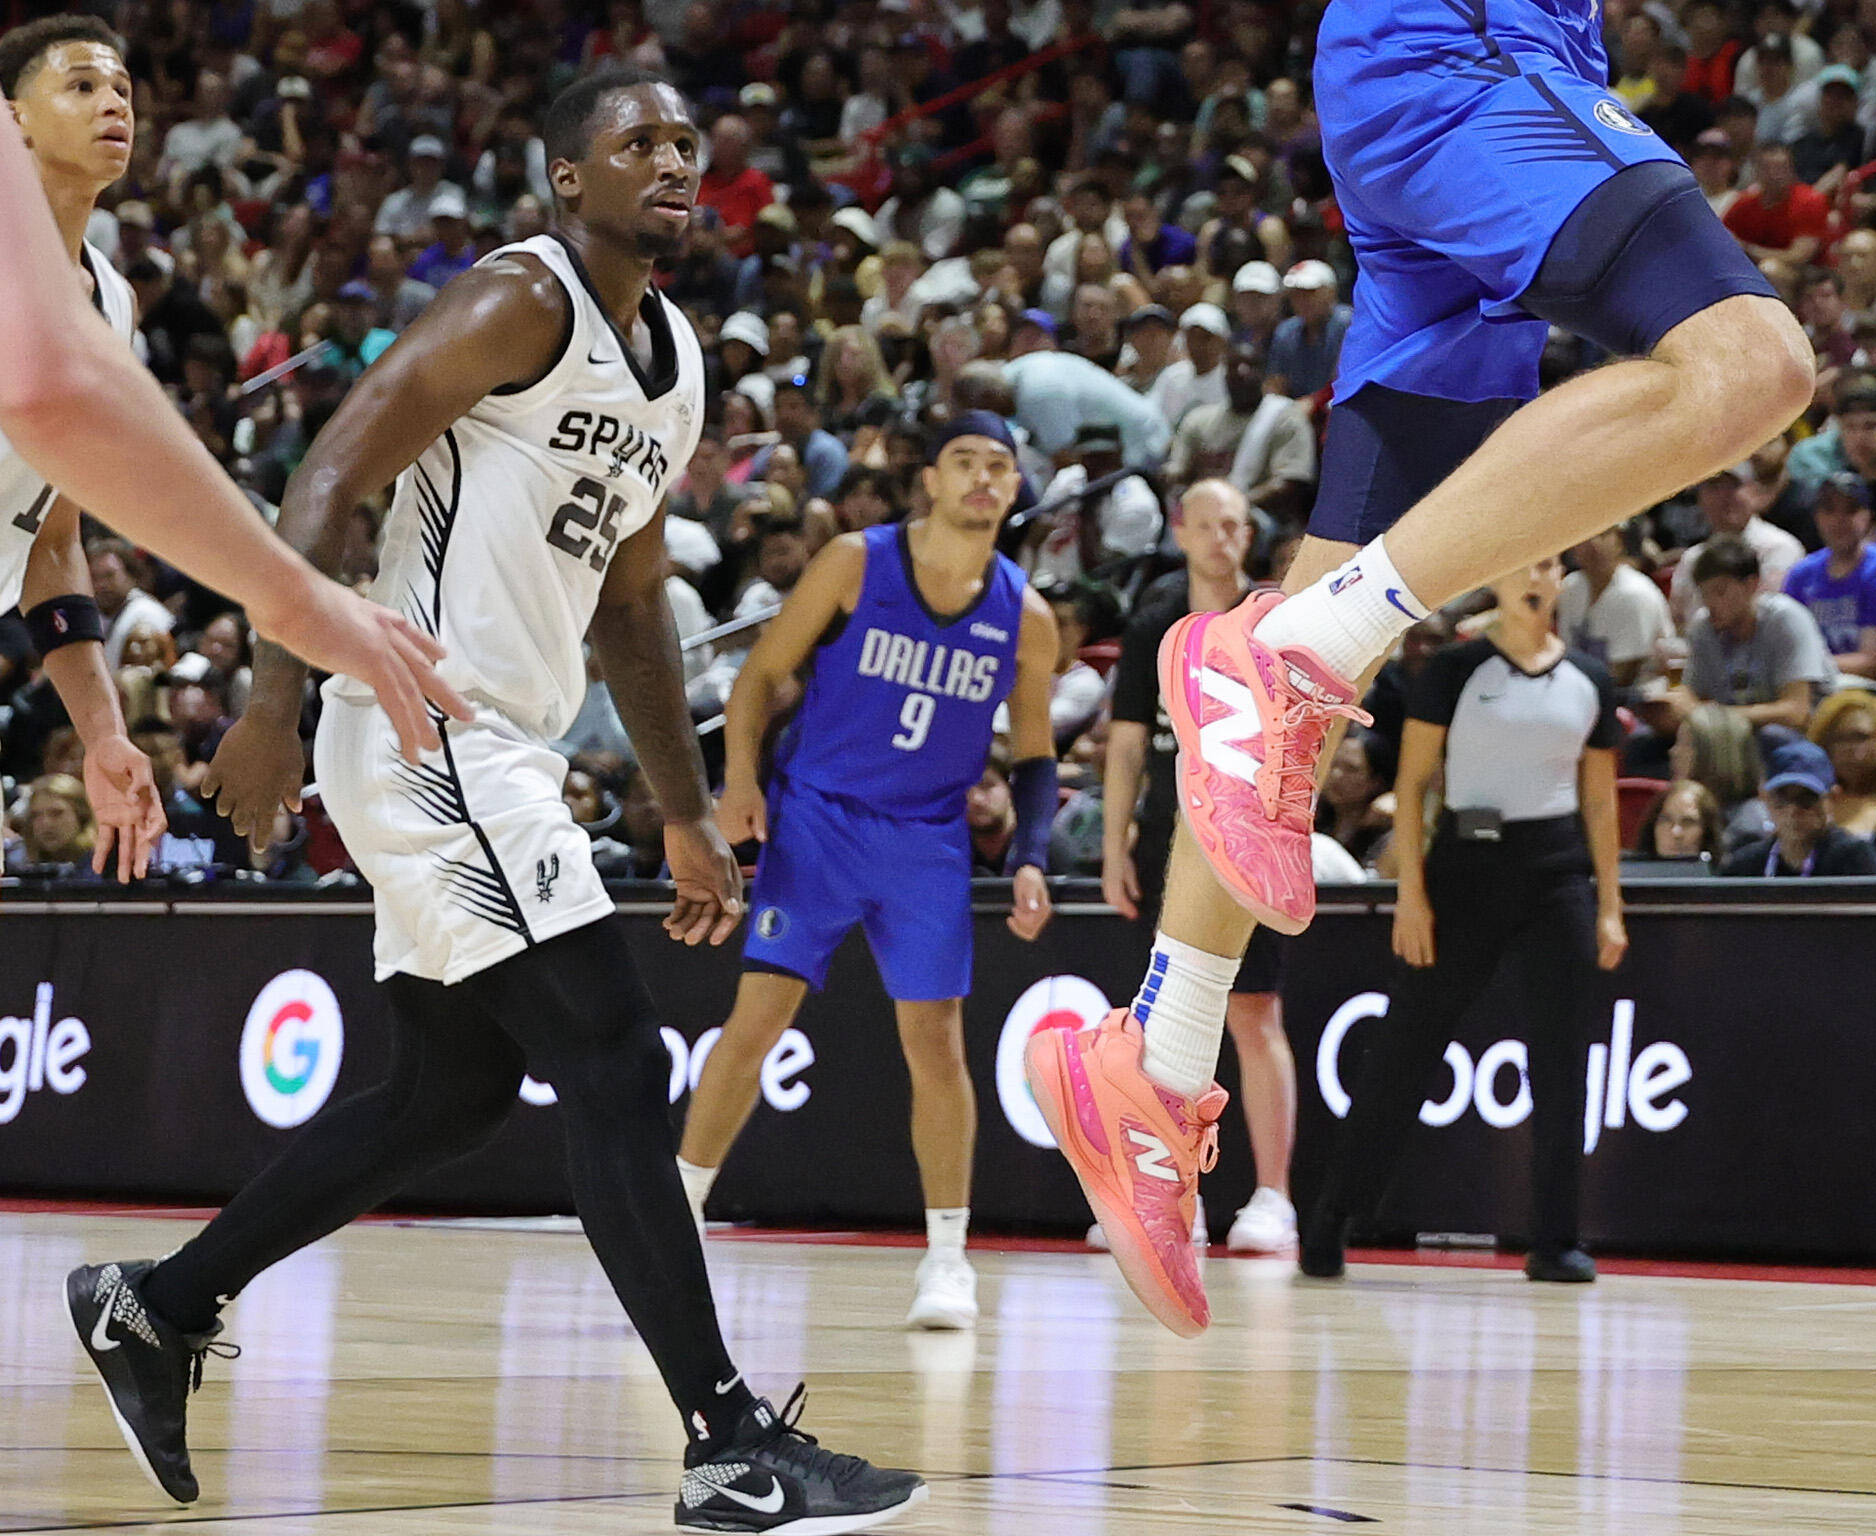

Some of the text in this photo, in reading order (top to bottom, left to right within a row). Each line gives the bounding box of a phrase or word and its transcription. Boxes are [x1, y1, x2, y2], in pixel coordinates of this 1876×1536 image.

[546, 476, 629, 574] 25
[858, 627, 1000, 703] DALLAS
[891, 692, 937, 751] 9
[263, 999, 322, 1096] G
